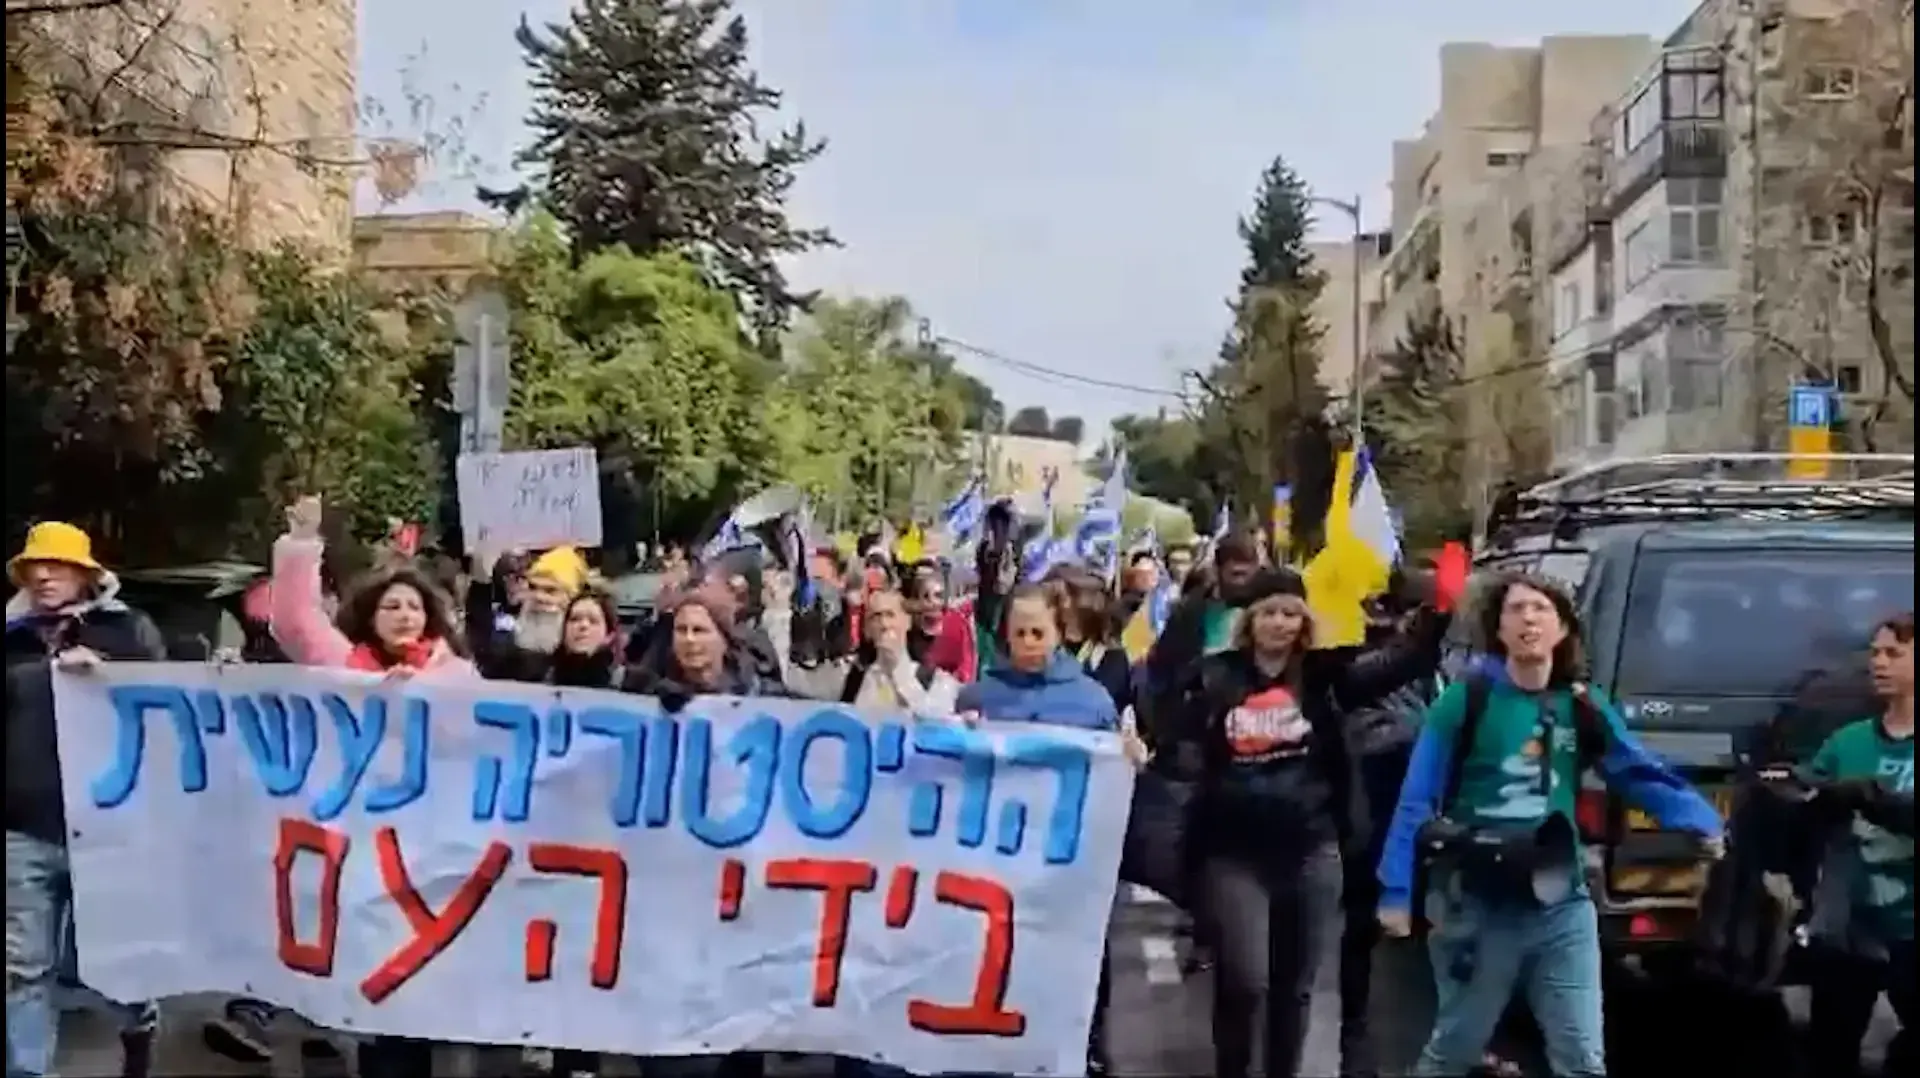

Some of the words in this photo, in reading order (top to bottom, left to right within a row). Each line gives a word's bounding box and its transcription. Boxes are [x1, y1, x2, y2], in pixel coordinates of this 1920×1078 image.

[90, 684, 431, 821] נעשית
[473, 701, 1091, 865] ההיסטוריה
[275, 817, 628, 1004] העם
[718, 857, 1027, 1037] בידי
